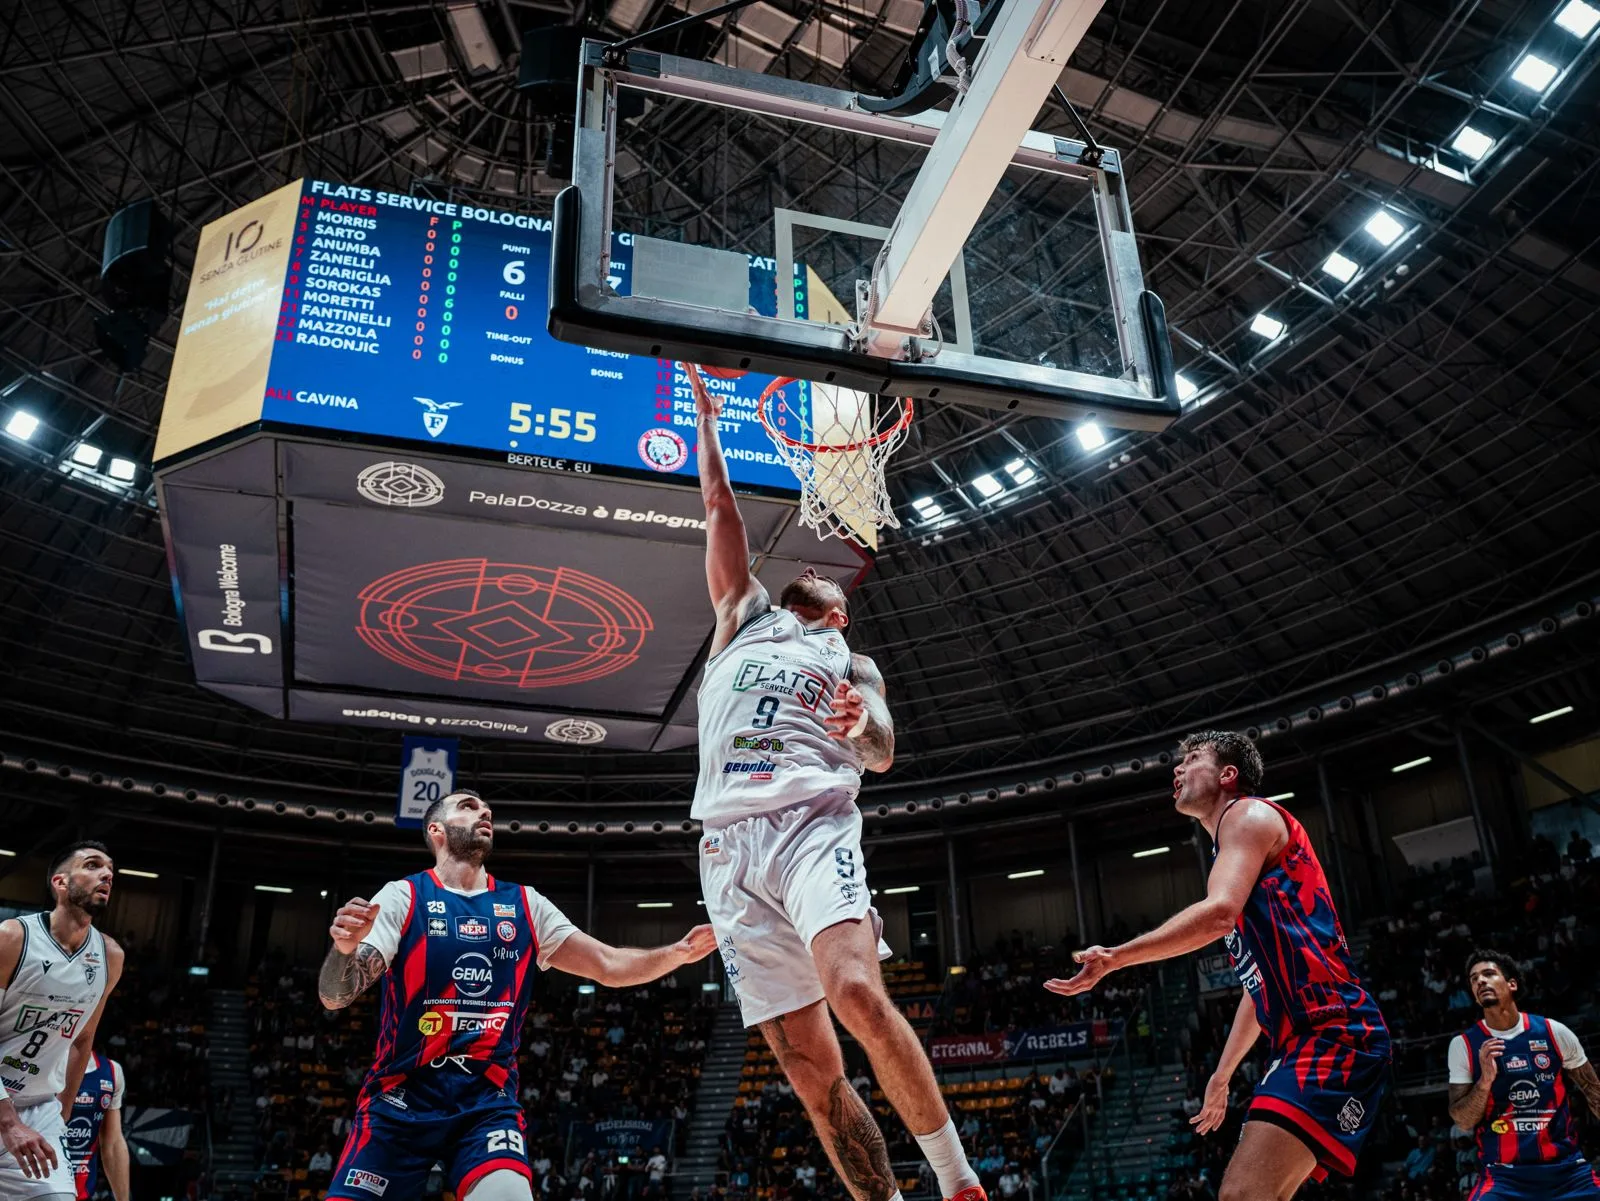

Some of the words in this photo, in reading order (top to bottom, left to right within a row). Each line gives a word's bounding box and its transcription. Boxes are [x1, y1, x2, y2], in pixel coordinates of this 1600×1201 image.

[301, 196, 315, 206] M
[320, 198, 377, 216] PLAYER
[430, 217, 439, 226] F
[452, 220, 463, 230] P
[311, 181, 371, 202] FLATS
[375, 191, 457, 216] SERVICE
[461, 205, 553, 232] BOLOGNA
[301, 208, 310, 219] 2
[317, 211, 377, 230] MORRIS
[427, 229, 437, 240] 0
[451, 233, 462, 244] 0
[299, 222, 308, 232] 3
[314, 224, 366, 241] SARTO
[425, 242, 435, 252] 0
[450, 246, 460, 256] 0
[502, 243, 531, 255] PUNTI
[200, 262, 234, 284] SENZA
[236, 238, 283, 266] GLUTINE
[295, 247, 304, 257] 7
[310, 250, 375, 269] ZANELLI
[422, 267, 432, 278] 0
[447, 271, 457, 282] 0
[296, 235, 306, 245] 6
[312, 237, 381, 257] ANUMBA
[424, 254, 433, 265] 0
[449, 258, 459, 269] 0
[308, 263, 392, 286] GUARIGLIA
[420, 280, 430, 291] 0
[446, 284, 456, 295] 0
[503, 260, 526, 285] 6
[284, 288, 299, 299] 11
[303, 290, 375, 311] MORETTI
[417, 307, 427, 318] 0
[443, 311, 453, 322] 0
[305, 277, 382, 298] SOROKAS
[419, 294, 428, 305] 0
[444, 298, 454, 309] 6
[499, 290, 525, 301] FALLI
[795, 291, 804, 301] 0
[280, 301, 297, 313] 21
[301, 304, 392, 328] FANTINELLI
[415, 321, 425, 332] 0
[441, 325, 451, 336] 0
[505, 305, 519, 320] 0
[796, 303, 804, 313] 0
[277, 315, 297, 328] 22
[298, 318, 378, 340] MAZZOLA
[414, 335, 424, 346] 0
[440, 338, 450, 349] 0
[485, 331, 533, 345] TIME-OUT
[275, 329, 294, 342] 23
[296, 332, 380, 355] RADONJIC
[412, 349, 422, 360] 0
[438, 352, 448, 364] 0
[585, 346, 630, 359] TIME-OUT
[490, 353, 525, 366] BONUS
[590, 368, 624, 380] BONUS
[656, 371, 671, 382] 17
[674, 373, 736, 393] PASONI
[265, 387, 295, 401] ALL
[295, 391, 359, 410] CAVINA
[655, 384, 671, 395] 25
[778, 402, 786, 413] 0
[507, 402, 597, 443] 5:55
[674, 414, 741, 433] BAETT
[778, 416, 787, 427] 0
[469, 491, 587, 516] PalaDozza
[217, 544, 239, 589] Welcome
[222, 590, 246, 627] Bologna
[738, 663, 821, 705] FLATS
[760, 682, 794, 696] SERVICE
[342, 709, 421, 724] Bologna
[751, 695, 780, 729] 9
[441, 717, 528, 734] PalaDozza
[410, 768, 447, 780] DOUGLAS
[413, 780, 440, 802] 20
[834, 847, 855, 880] 9
[427, 900, 446, 914] 29
[458, 923, 488, 935] NERI
[452, 967, 493, 982] GEMA
[19, 1009, 81, 1034] FLATS
[20, 1030, 48, 1058] 8
[931, 1042, 993, 1058] ETERNAL
[1027, 1031, 1087, 1049] REBELS
[1508, 1089, 1540, 1100] GEMA
[65, 1128, 92, 1139] GEMA
[486, 1129, 525, 1156] 29
[356, 1171, 380, 1185] oma
